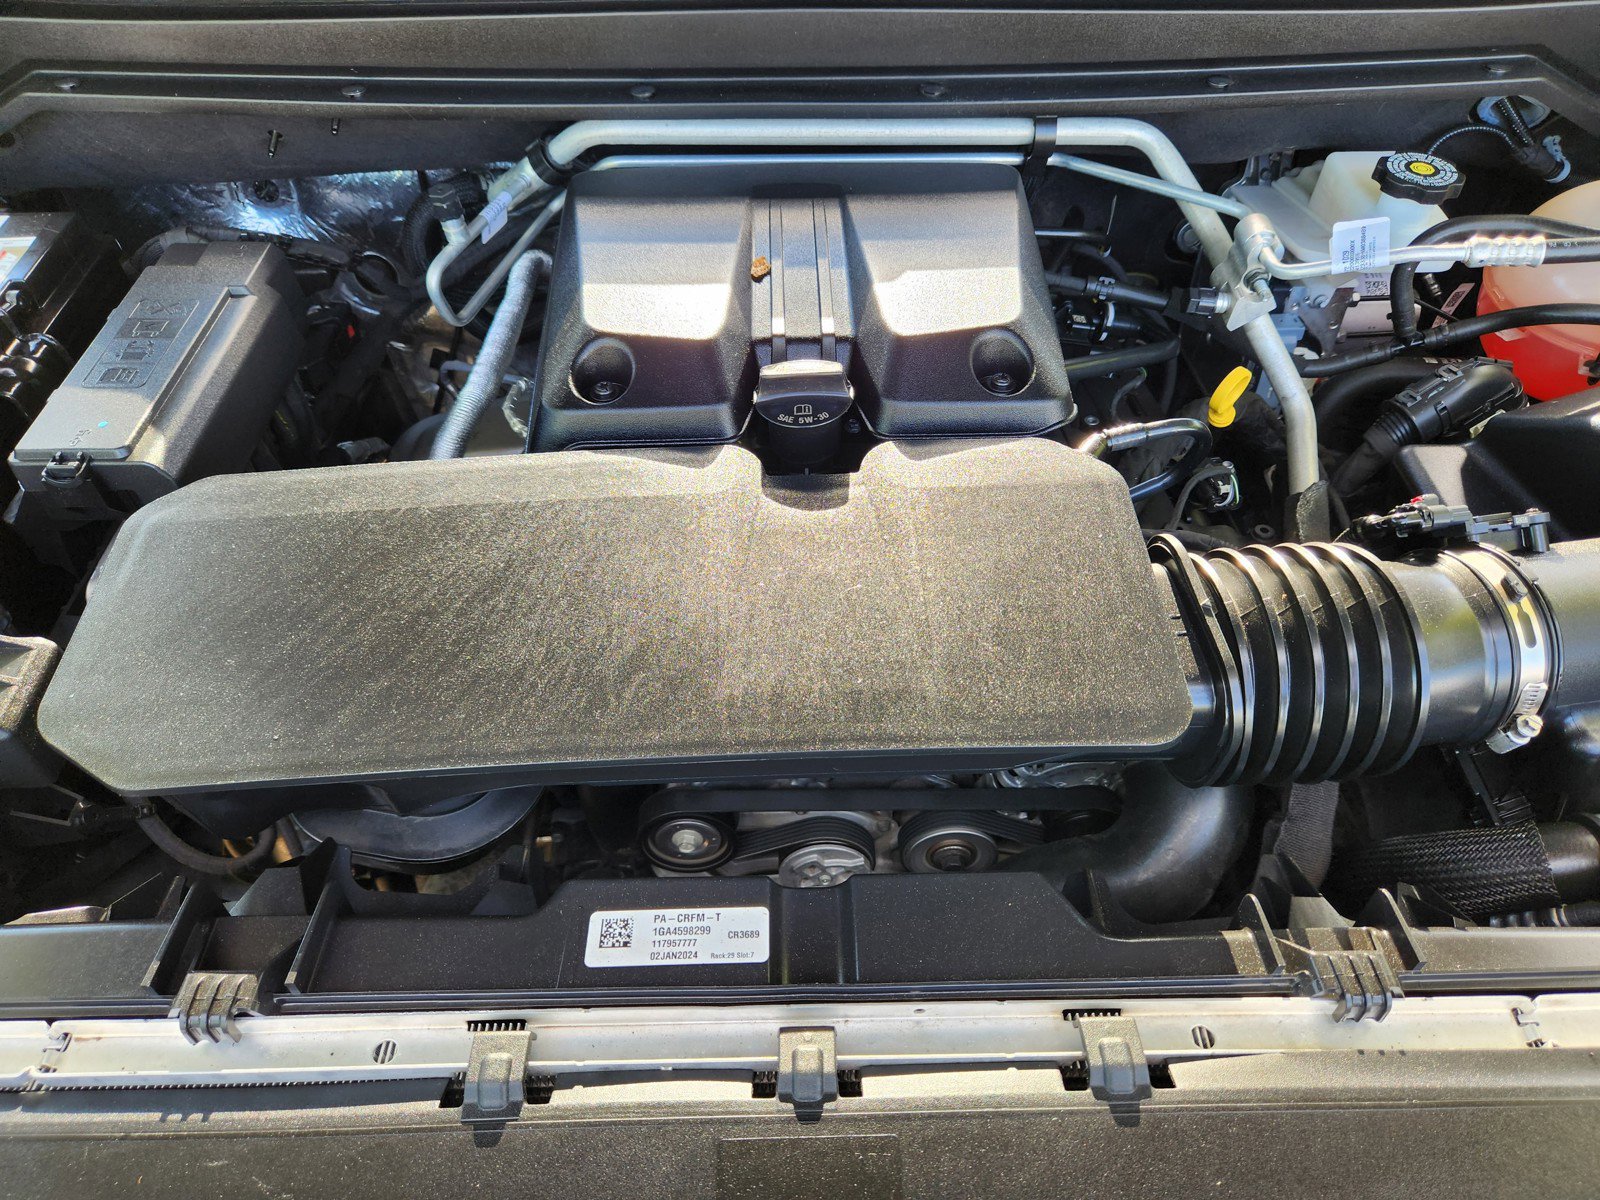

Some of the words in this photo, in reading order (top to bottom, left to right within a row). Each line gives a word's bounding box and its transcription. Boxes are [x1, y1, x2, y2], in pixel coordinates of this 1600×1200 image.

[777, 413, 795, 423] SAE
[798, 411, 829, 424] 5W-30
[652, 925, 711, 936] 1GA4598299
[727, 930, 760, 939] CR3689
[652, 939, 698, 948] 117957777
[650, 951, 698, 961] 02JAN2024
[736, 951, 755, 959] Slot:7
